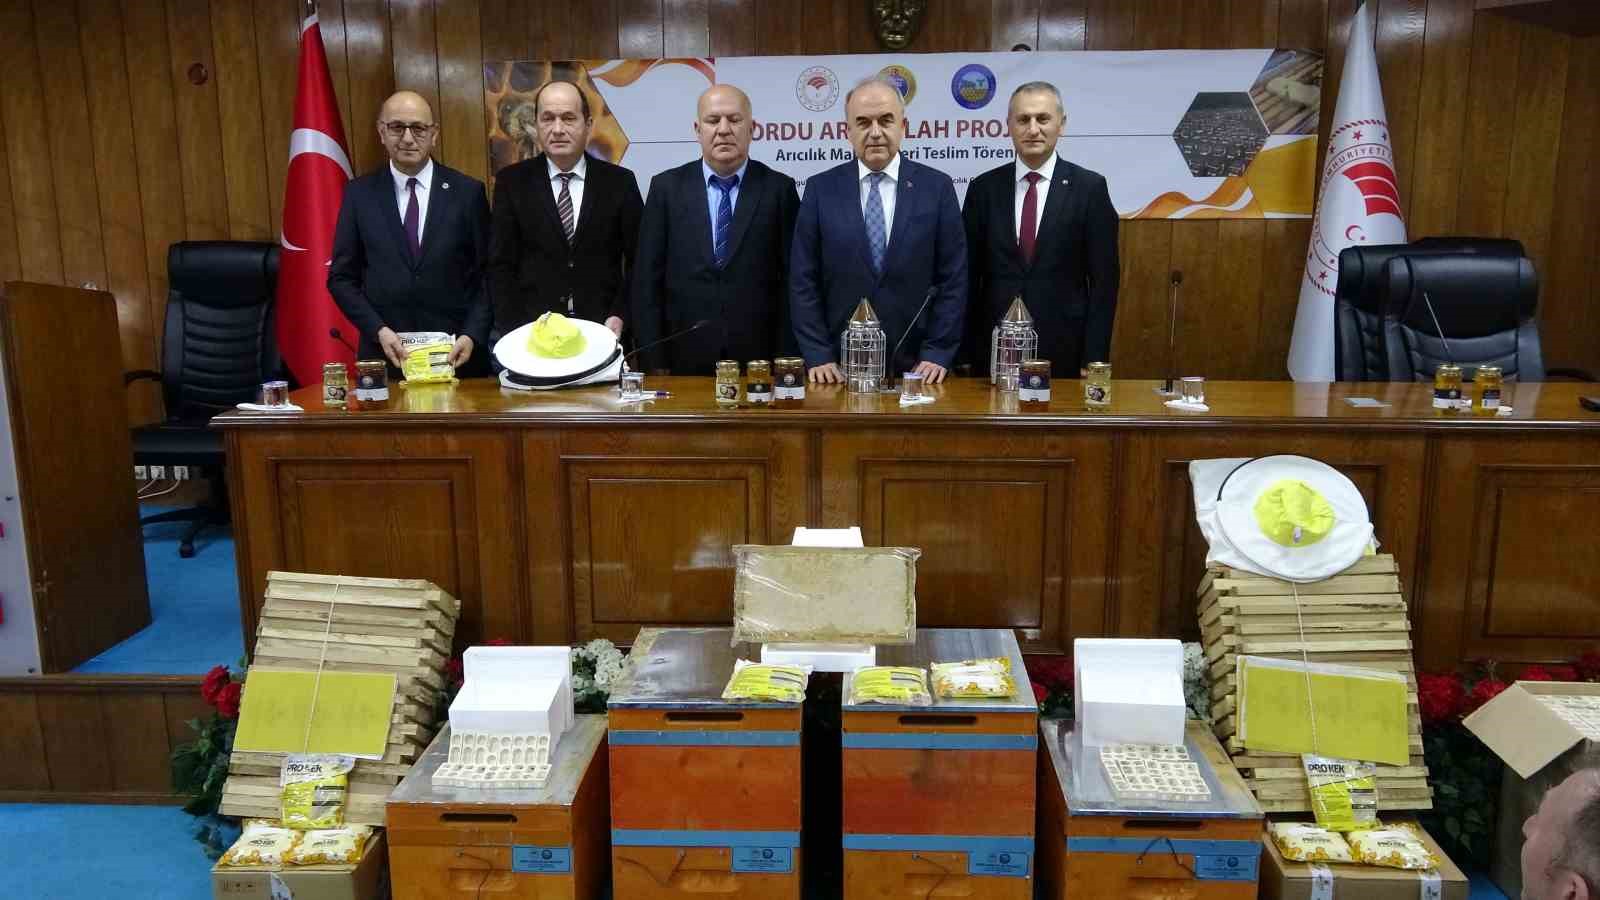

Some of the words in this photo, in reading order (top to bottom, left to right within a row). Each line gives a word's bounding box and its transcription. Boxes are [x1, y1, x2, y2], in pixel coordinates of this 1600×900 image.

[751, 122, 813, 141] ORDU
[820, 121, 848, 140] AR
[904, 119, 949, 139] LAH
[956, 119, 1010, 139] PROJ
[775, 148, 827, 161] Arıcılık
[923, 146, 969, 160] Teslim
[972, 145, 1015, 160] Tören
[1307, 763, 1328, 774] PRO
